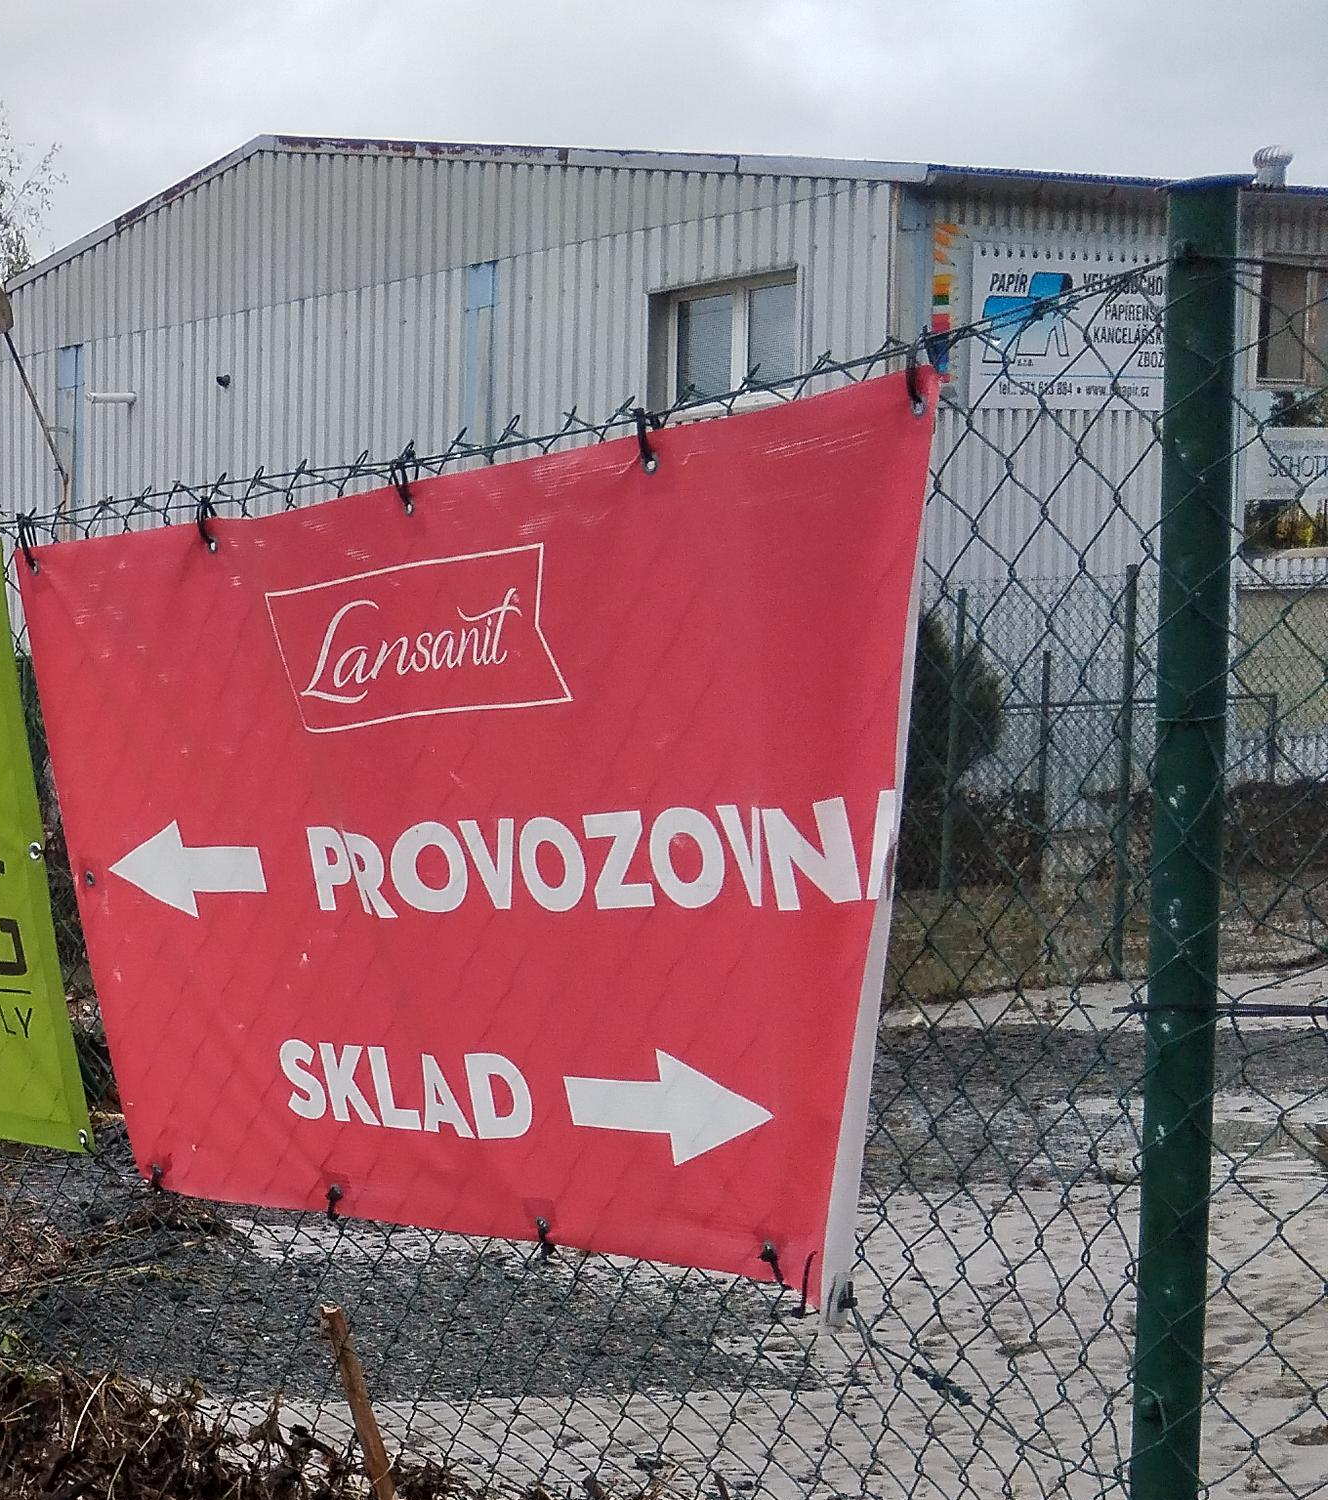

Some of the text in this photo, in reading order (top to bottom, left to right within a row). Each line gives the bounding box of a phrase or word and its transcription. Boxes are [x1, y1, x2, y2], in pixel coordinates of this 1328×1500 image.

[989, 267, 1028, 293] PAPÍR
[300, 587, 523, 703] Lansanit
[279, 1039, 533, 1140] SKLAD
